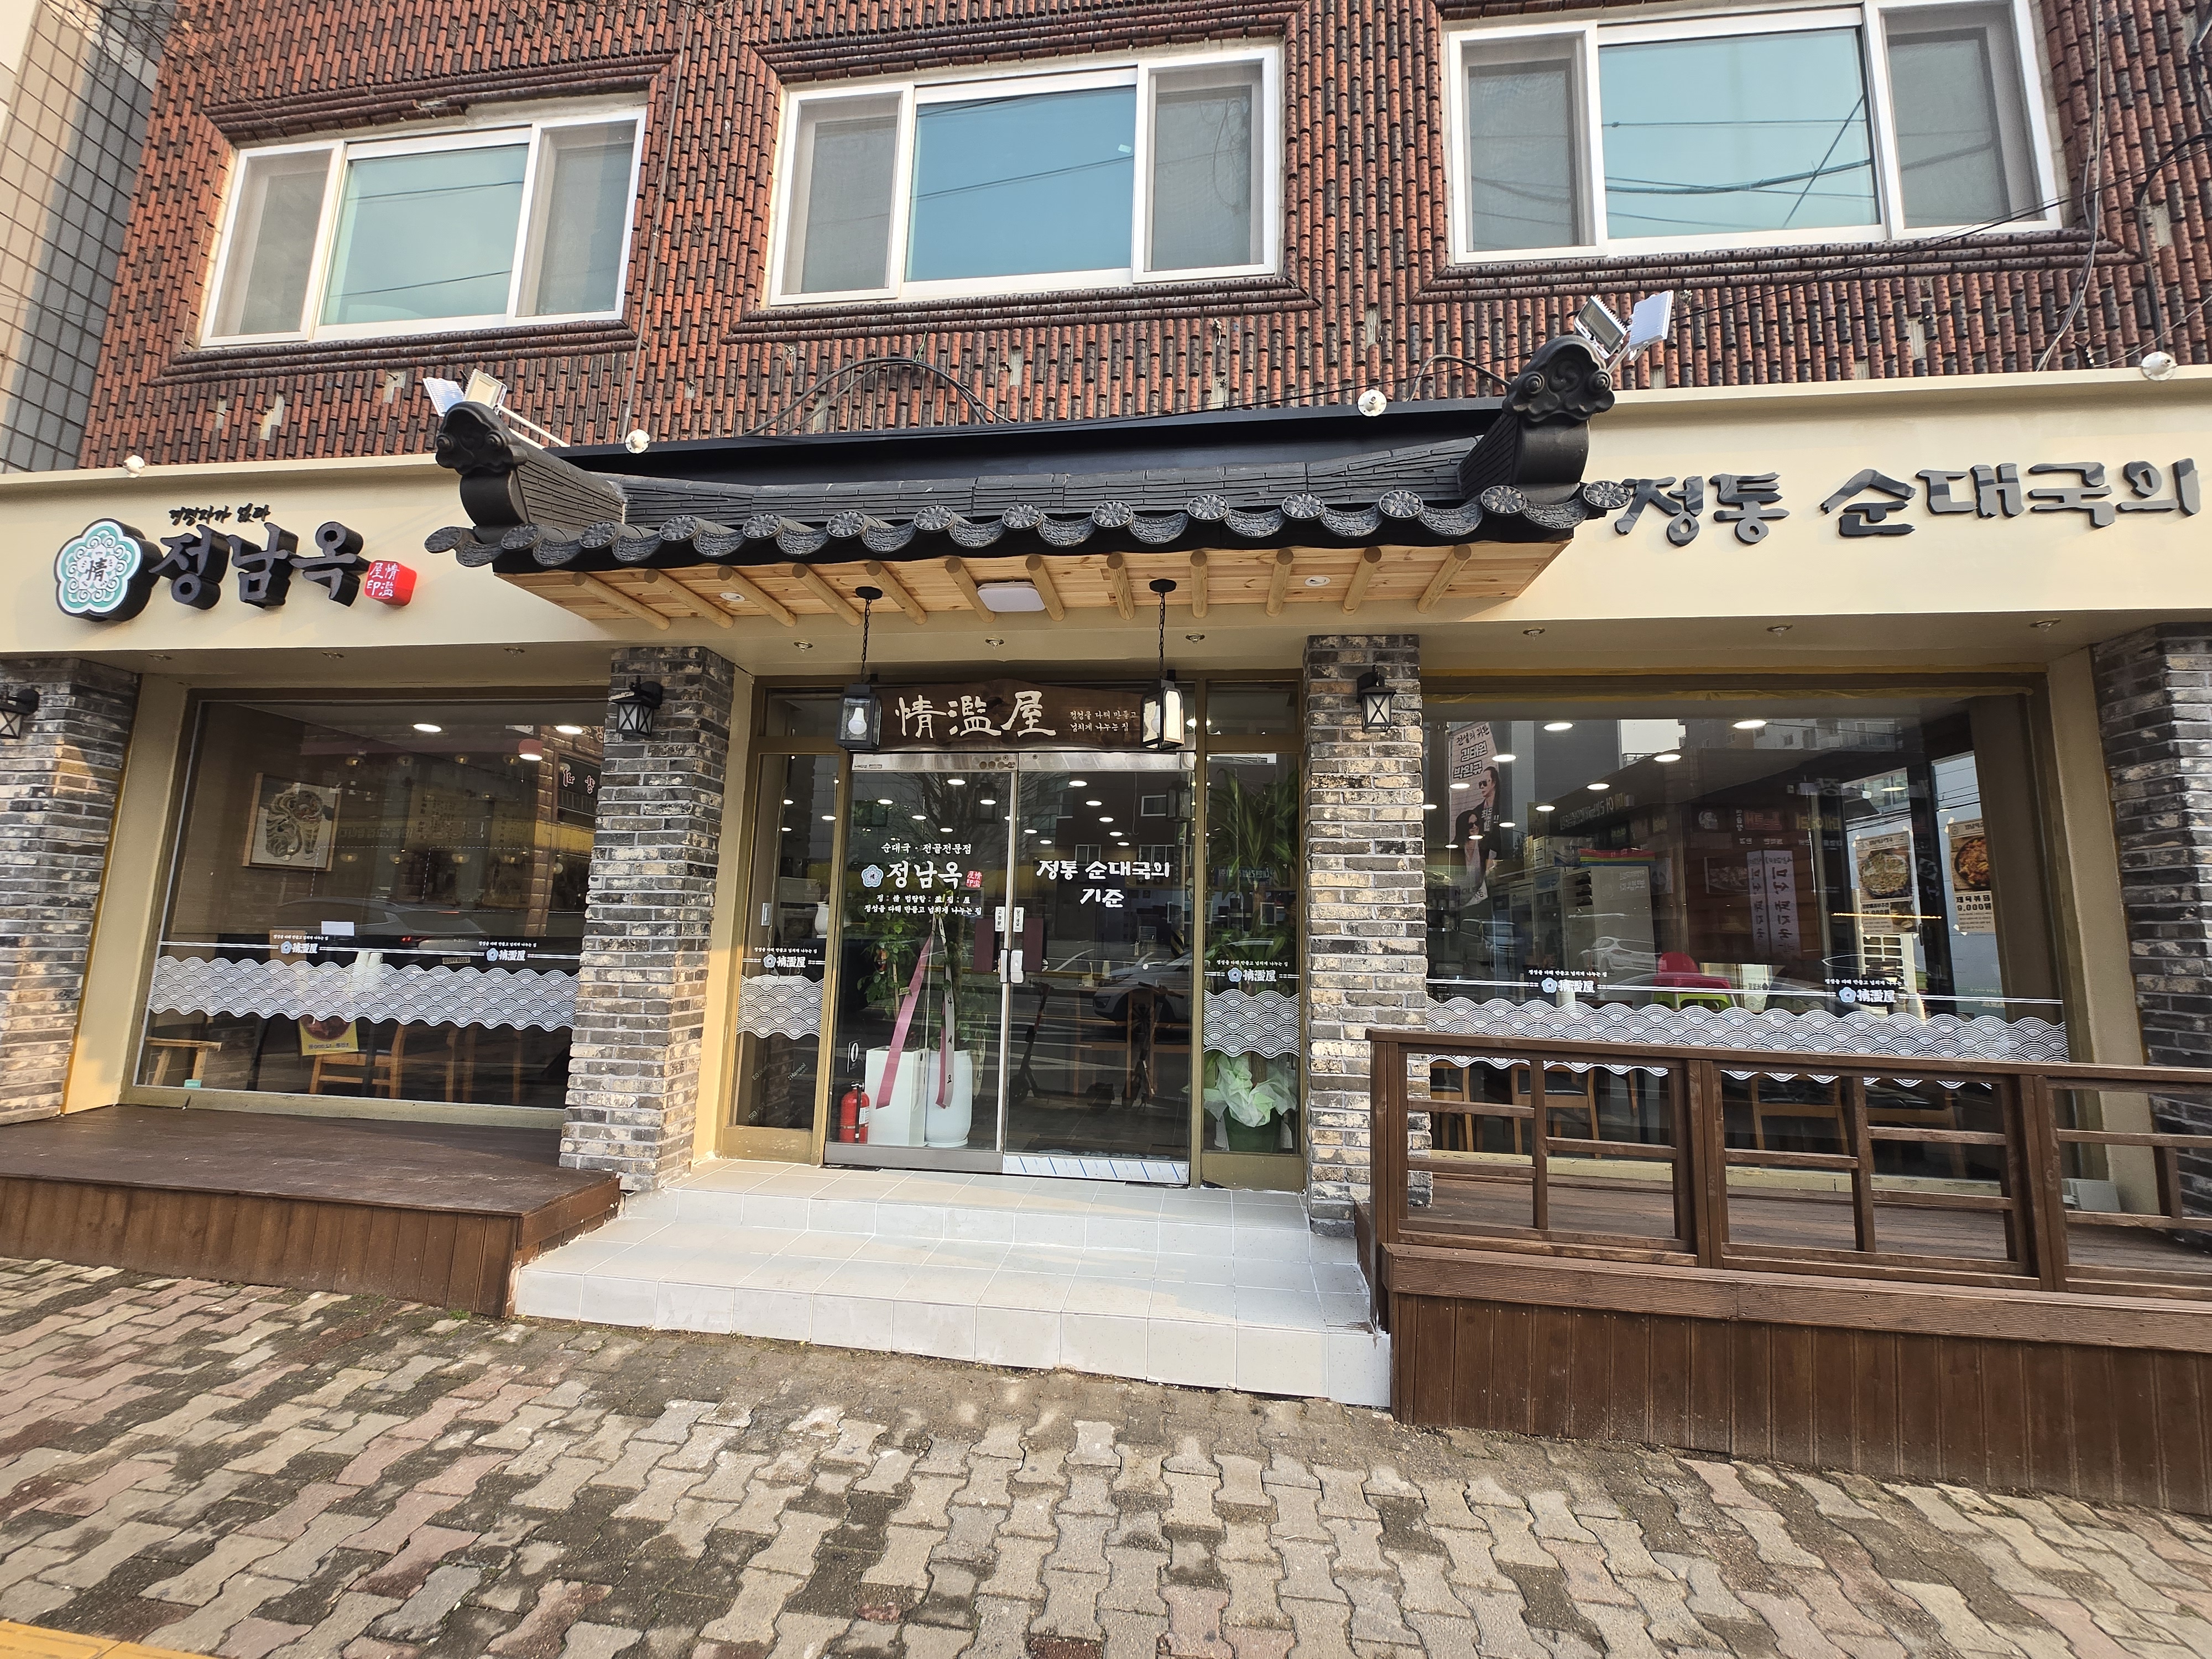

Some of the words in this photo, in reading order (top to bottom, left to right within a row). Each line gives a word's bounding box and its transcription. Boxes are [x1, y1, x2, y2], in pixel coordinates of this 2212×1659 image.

[1614, 471, 1790, 546] 정통
[1817, 458, 2200, 538] 순대국의
[149, 522, 365, 608] 정남옥
[895, 690, 1056, 739] 情濫屋
[1094, 710, 1110, 719] 다해
[1113, 710, 1138, 720] 만들고
[1070, 722, 1093, 732] 넘치게
[1095, 722, 1119, 732] 나누는
[1121, 722, 1129, 732] 집
[1460, 740, 1489, 763] 김태원
[1453, 759, 1483, 779] 박완규
[881, 842, 911, 854] 순대국
[922, 843, 972, 855] 전골전문점
[886, 860, 963, 890] 정남옥
[1036, 860, 1079, 880] 정통
[1085, 859, 1170, 880] 순대국의
[864, 905, 886, 913] 정성을
[1080, 888, 1125, 909] 기준
